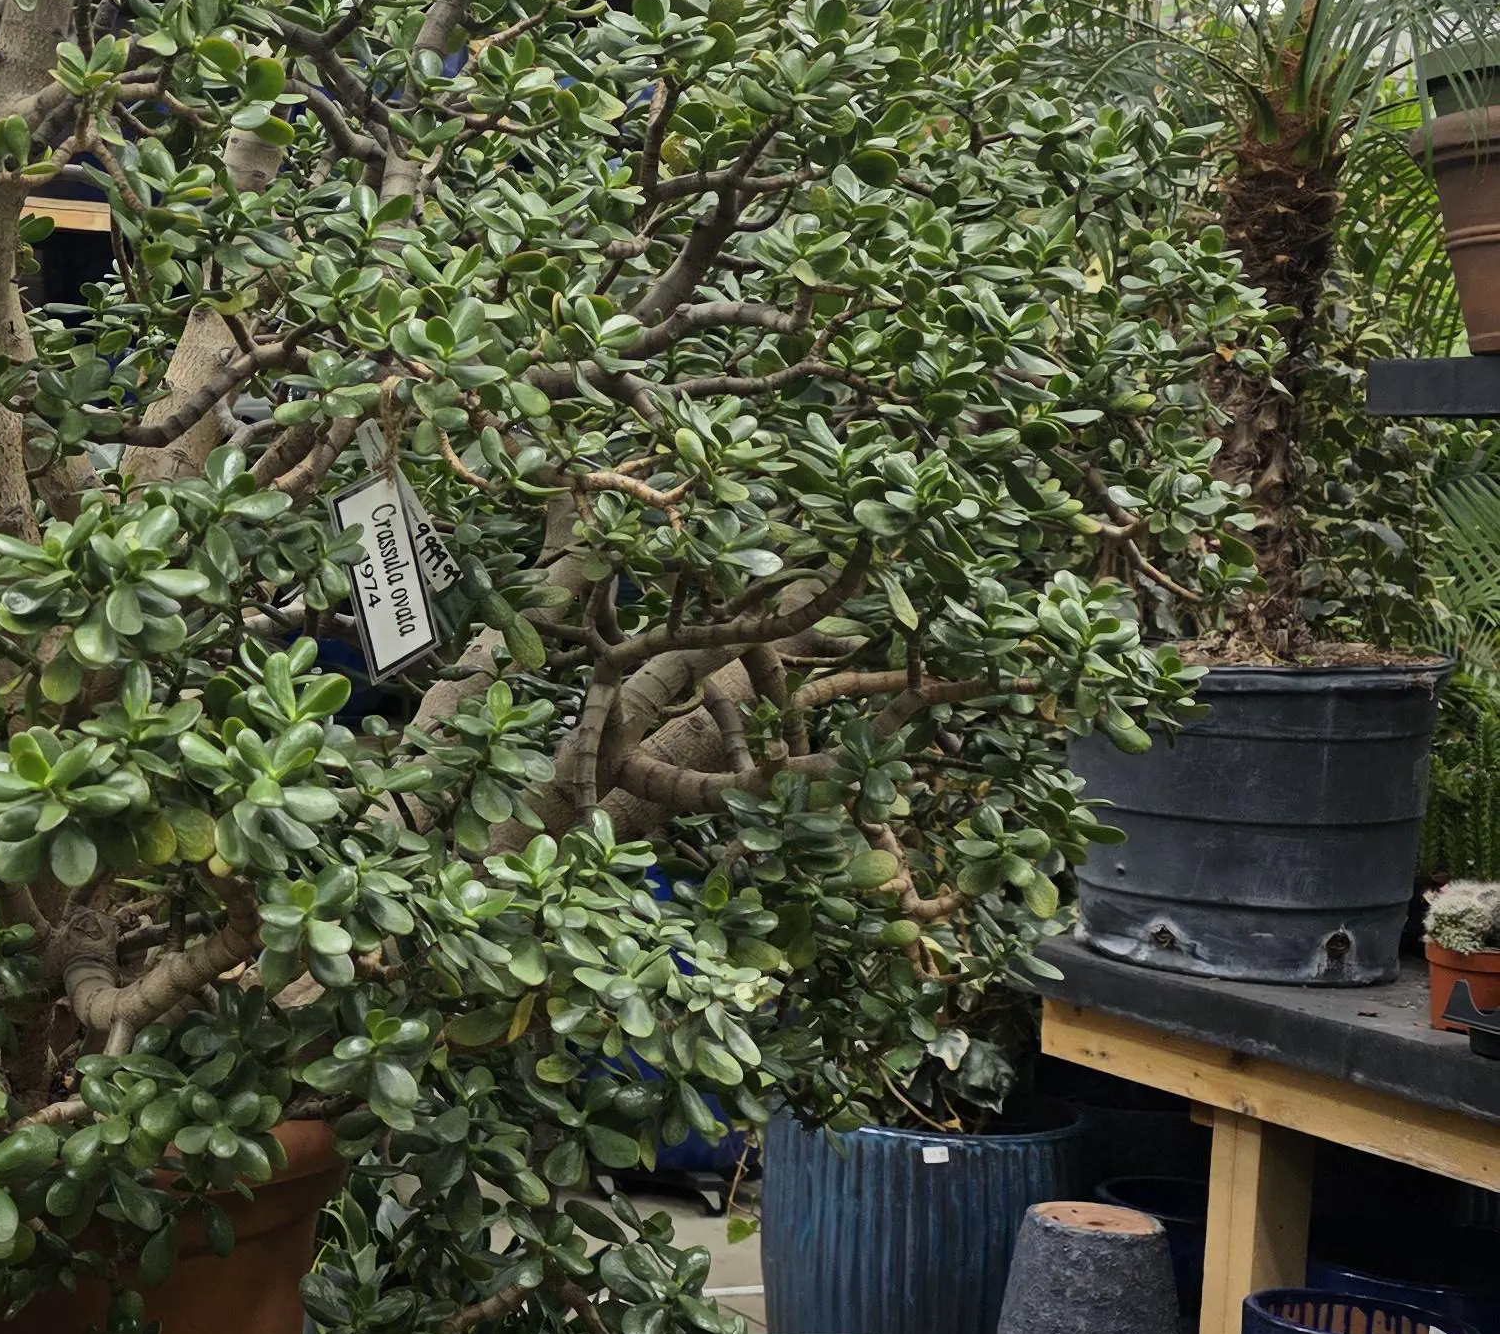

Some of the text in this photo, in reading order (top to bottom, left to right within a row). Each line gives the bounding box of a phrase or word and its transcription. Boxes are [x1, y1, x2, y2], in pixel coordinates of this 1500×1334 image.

[359, 553, 381, 608] 1974
[371, 503, 416, 637] Crassula ovata
